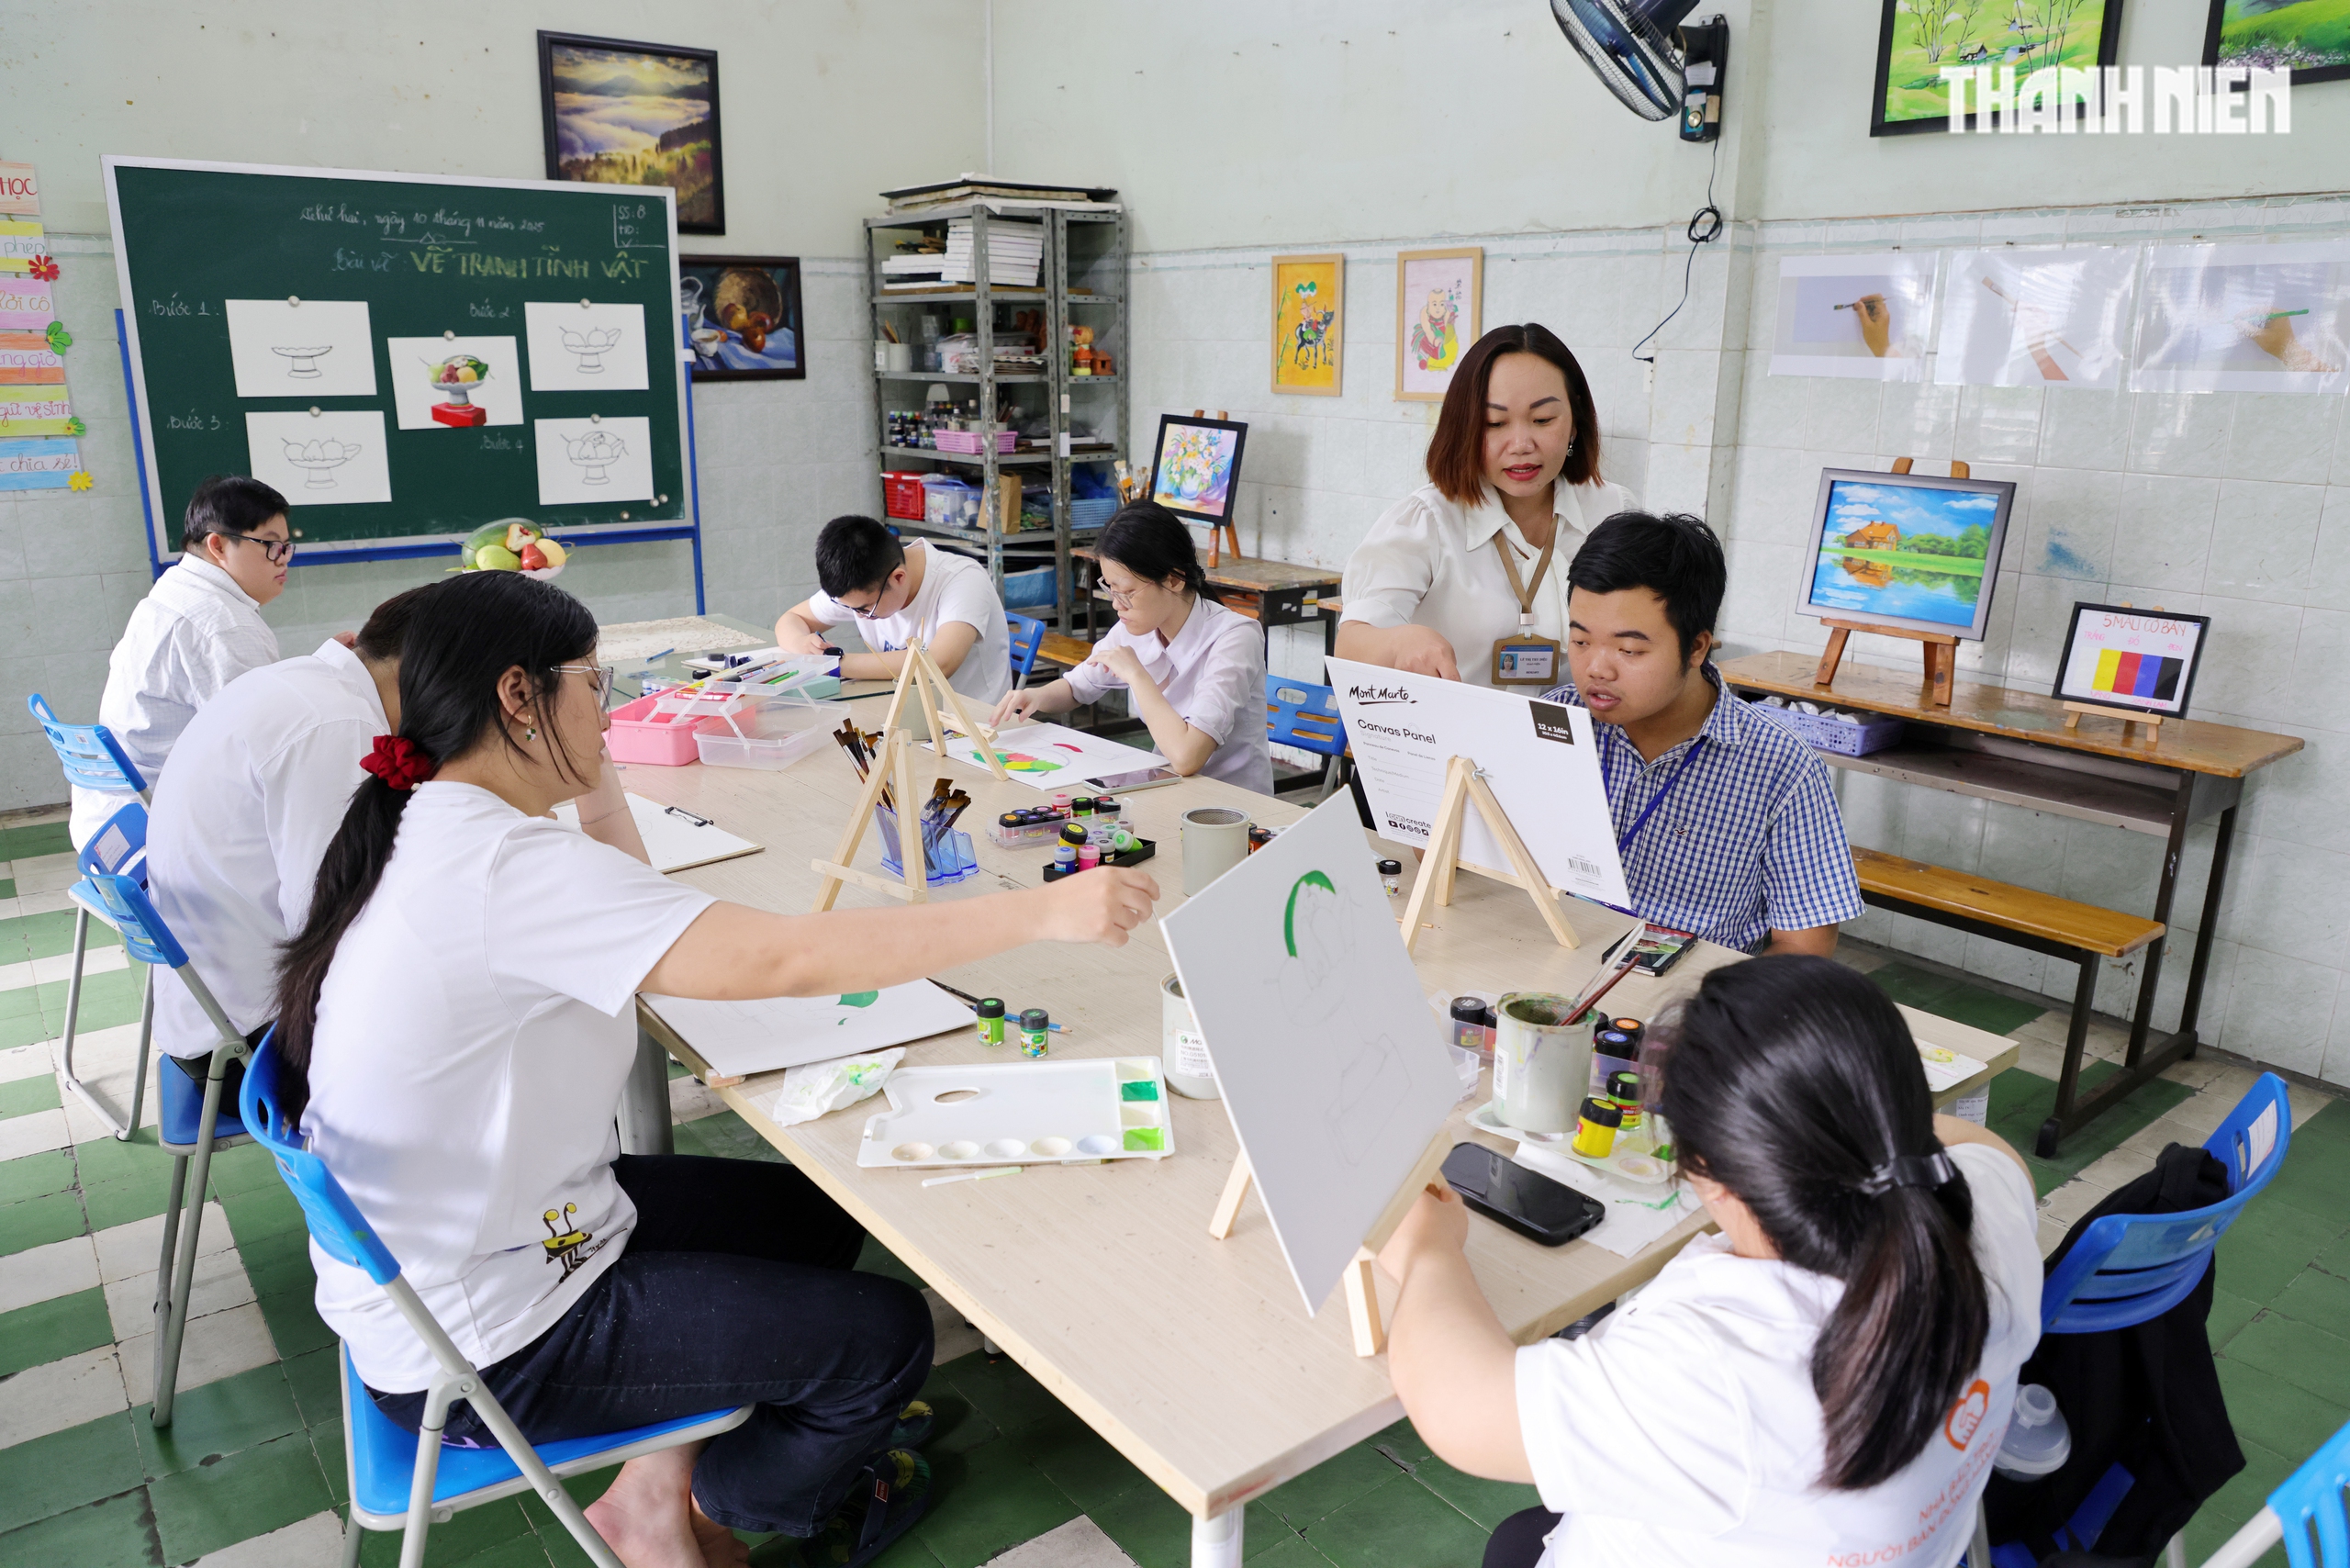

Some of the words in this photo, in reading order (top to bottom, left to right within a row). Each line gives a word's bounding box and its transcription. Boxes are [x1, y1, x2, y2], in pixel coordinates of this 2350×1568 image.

[375, 211, 405, 235] ngày
[433, 208, 471, 237] tháng
[4, 235, 45, 260] phép
[409, 245, 453, 274] VẼ
[457, 252, 527, 279] TRANH
[532, 244, 588, 278] TĨNH
[600, 251, 649, 284] VẬT
[29, 296, 50, 312] cô
[44, 400, 72, 417] sinh
[10, 453, 48, 472] chia
[2103, 614, 2112, 628] 5
[1349, 684, 1377, 700] Mont
[1377, 686, 1409, 701] Marte
[1358, 719, 1401, 737] Canvas
[1403, 728, 1437, 745] Panel
[1538, 722, 1547, 731] 12
[1360, 730, 1392, 743] Signature
[1406, 818, 1431, 829] create
